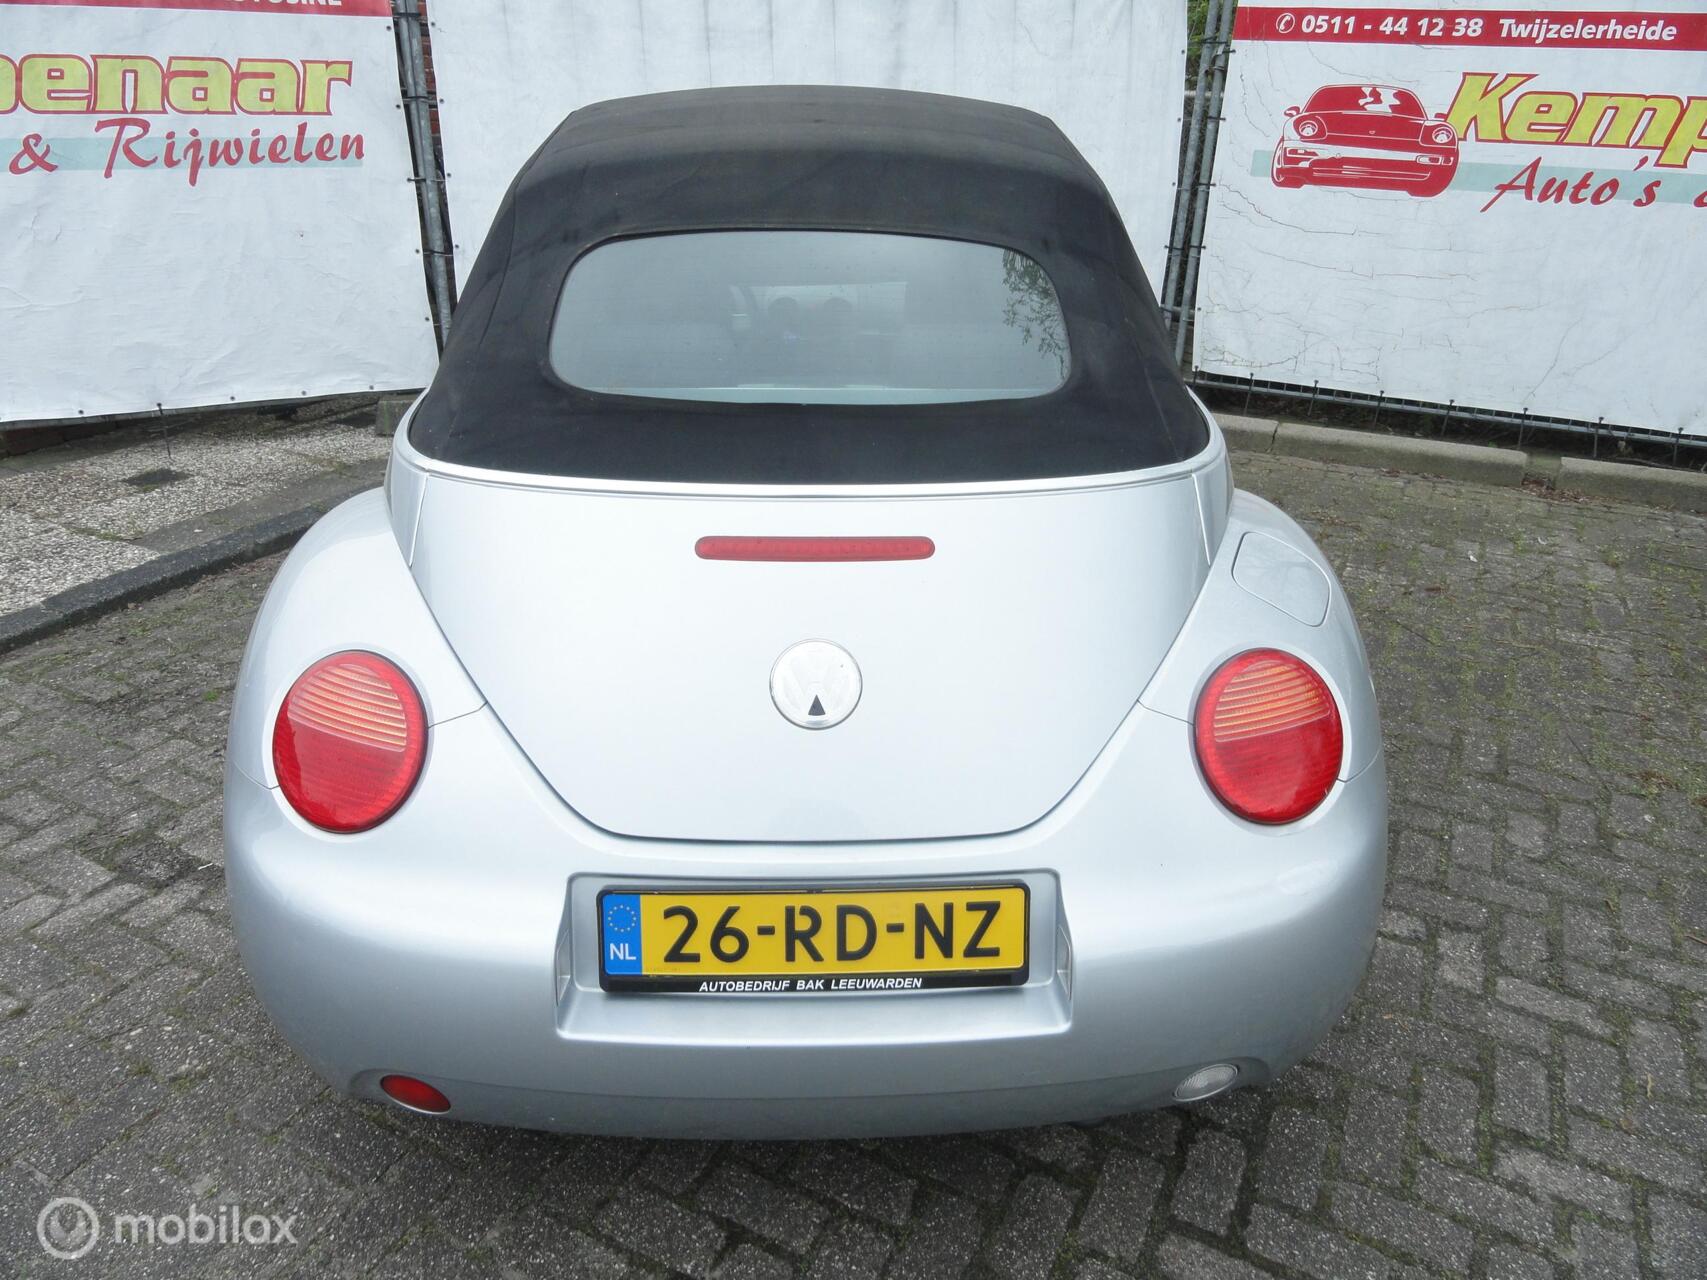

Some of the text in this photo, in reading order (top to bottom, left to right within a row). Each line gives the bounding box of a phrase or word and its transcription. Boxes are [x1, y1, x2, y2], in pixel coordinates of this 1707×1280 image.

[1301, 15, 1355, 34] 0511
[1379, 17, 1408, 35] 44
[1417, 18, 1444, 36] 12
[1452, 18, 1484, 37] 38
[1499, 18, 1677, 44] Twijzelerheide
[0, 54, 353, 116] enaar
[9, 117, 365, 187] & Rijwielen
[1480, 155, 1661, 212] Auto's
[609, 942, 637, 960] NL
[662, 901, 1001, 964] 26-RD-NZ
[699, 977, 923, 992] AUTOBEDRIJF BAK LEEUWARDEN
